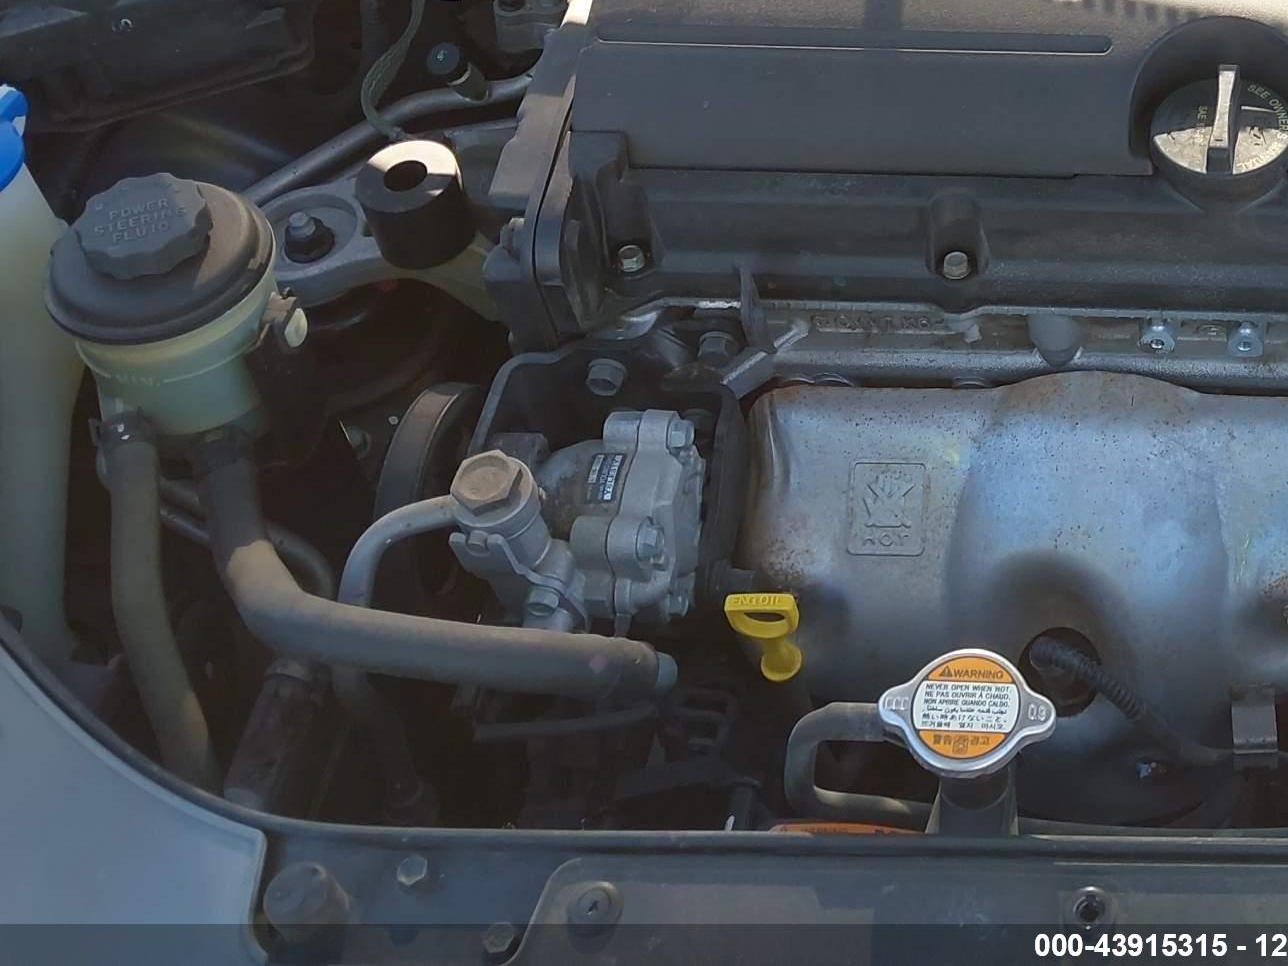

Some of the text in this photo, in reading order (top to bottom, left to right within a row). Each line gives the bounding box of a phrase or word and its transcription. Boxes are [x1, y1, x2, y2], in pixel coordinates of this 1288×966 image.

[1247, 84, 1270, 99] SEE
[109, 198, 169, 221] POWER
[112, 223, 169, 243] FLUID
[759, 595, 781, 606] OIL
[952, 670, 1004, 680] WARNING
[926, 683, 948, 691] NEVER
[938, 698, 960, 706] APRIRE
[961, 699, 987, 707] QUANDO
